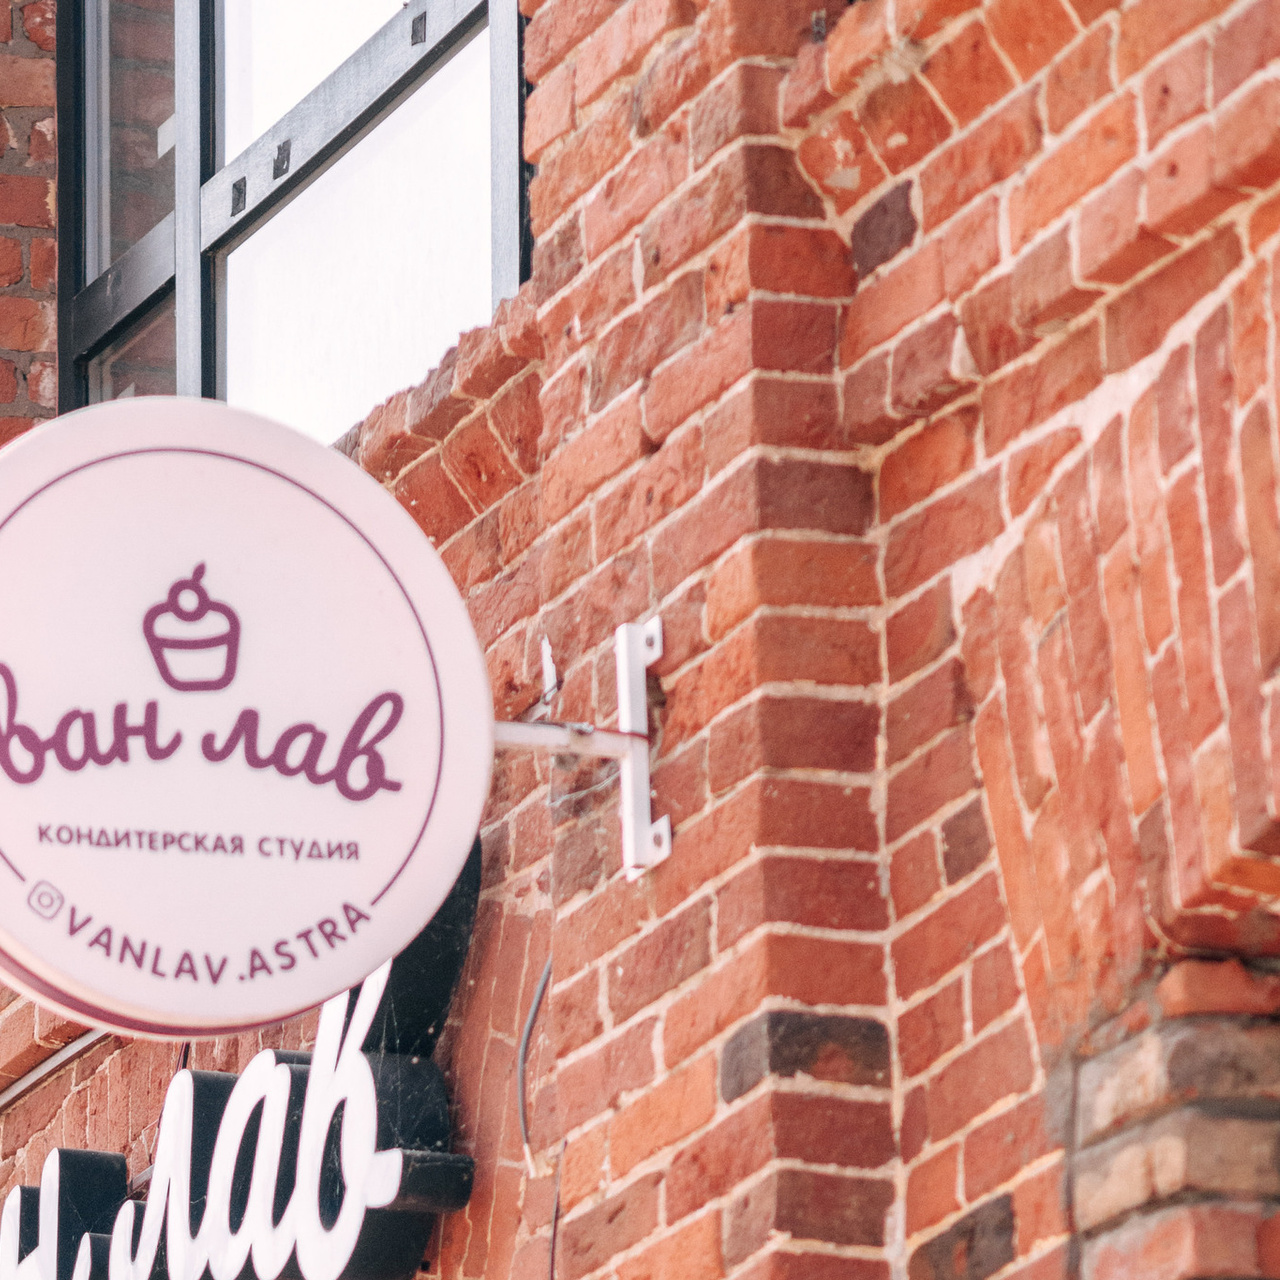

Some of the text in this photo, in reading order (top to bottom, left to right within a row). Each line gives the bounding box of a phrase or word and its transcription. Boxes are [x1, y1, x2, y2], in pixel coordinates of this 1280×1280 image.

[203, 692, 405, 801] лав
[38, 824, 360, 861] КОНДИТЕРСКАЯ СТУДИЯ
[68, 902, 370, 985] VANLAV.ASTRA
